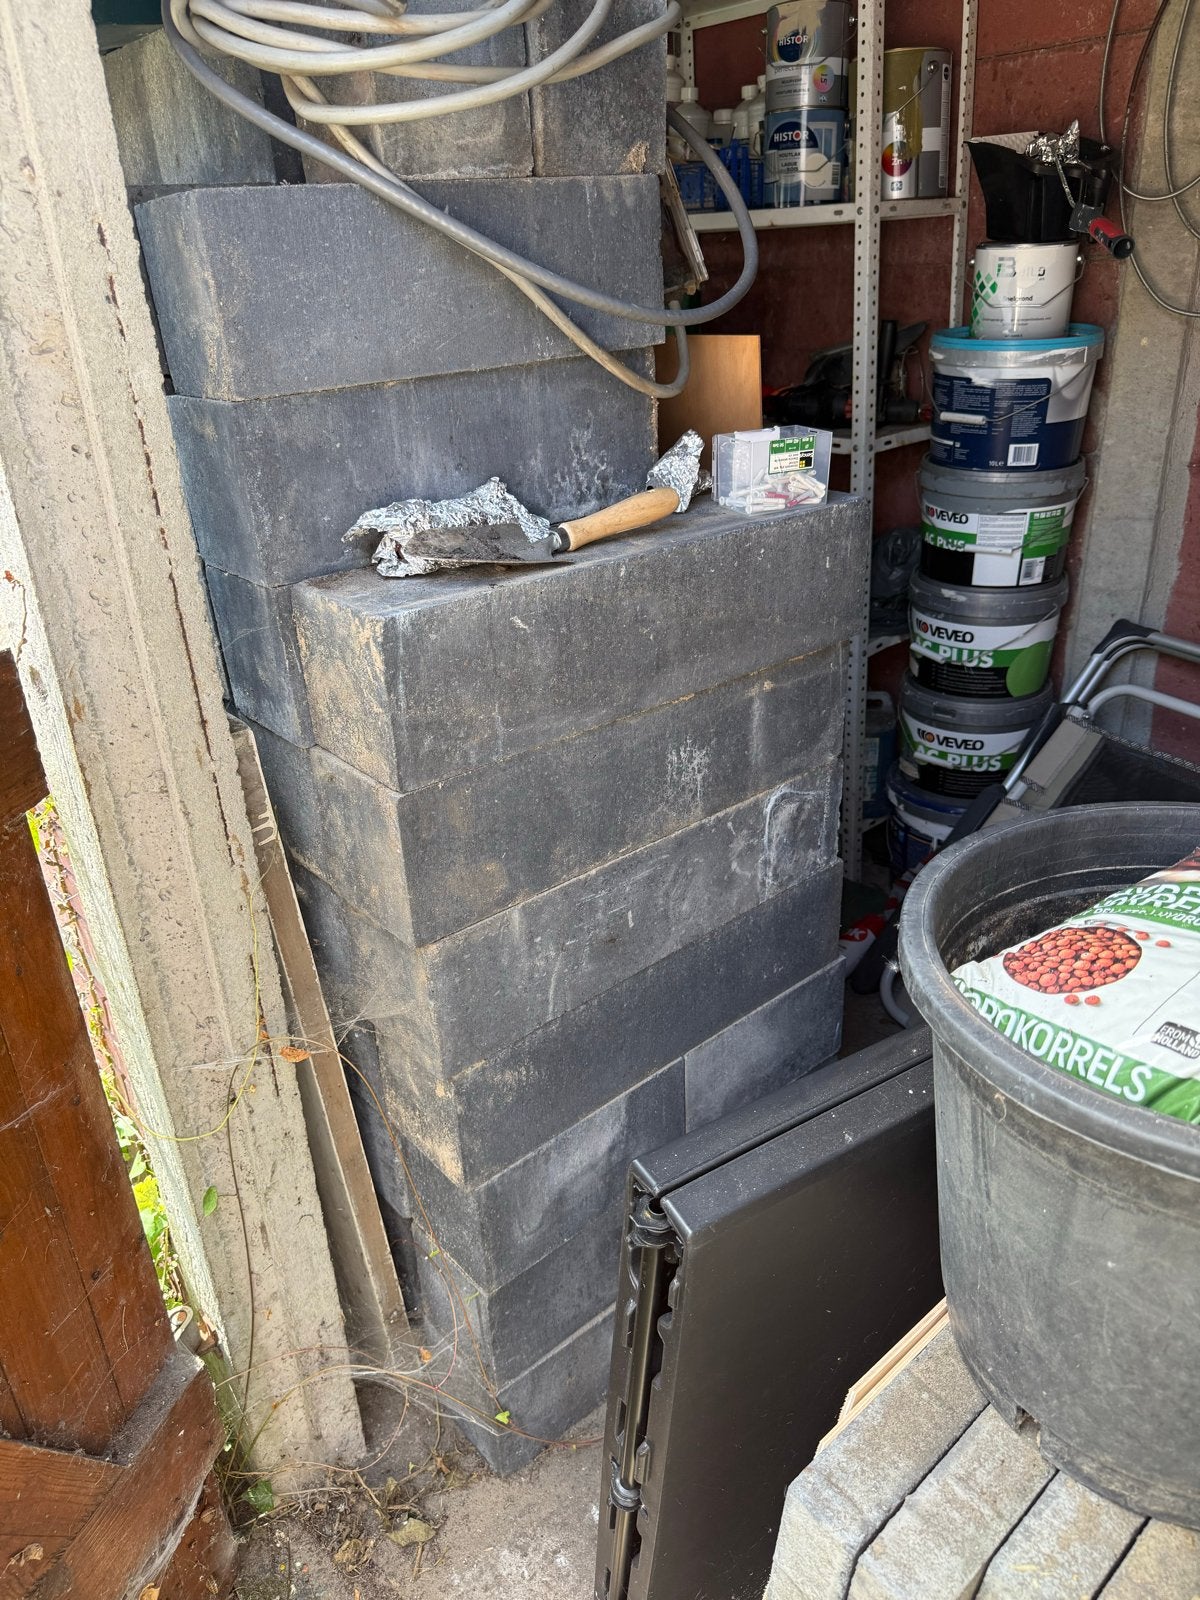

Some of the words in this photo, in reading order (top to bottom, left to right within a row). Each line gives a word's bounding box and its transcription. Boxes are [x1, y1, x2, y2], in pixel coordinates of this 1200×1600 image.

[779, 35, 809, 46] HISTOR
[773, 130, 809, 143] HISTOR
[935, 509, 969, 525] VEVEO
[924, 532, 935, 545] AC
[937, 536, 966, 552] PLUS
[930, 624, 974, 643] VEVEO
[938, 645, 994, 668] PLUS
[936, 734, 985, 751] VEVEO
[947, 755, 1002, 772] PLUS
[1159, 1025, 1191, 1044] FROM
[1151, 1032, 1200, 1058] HOLLAND
